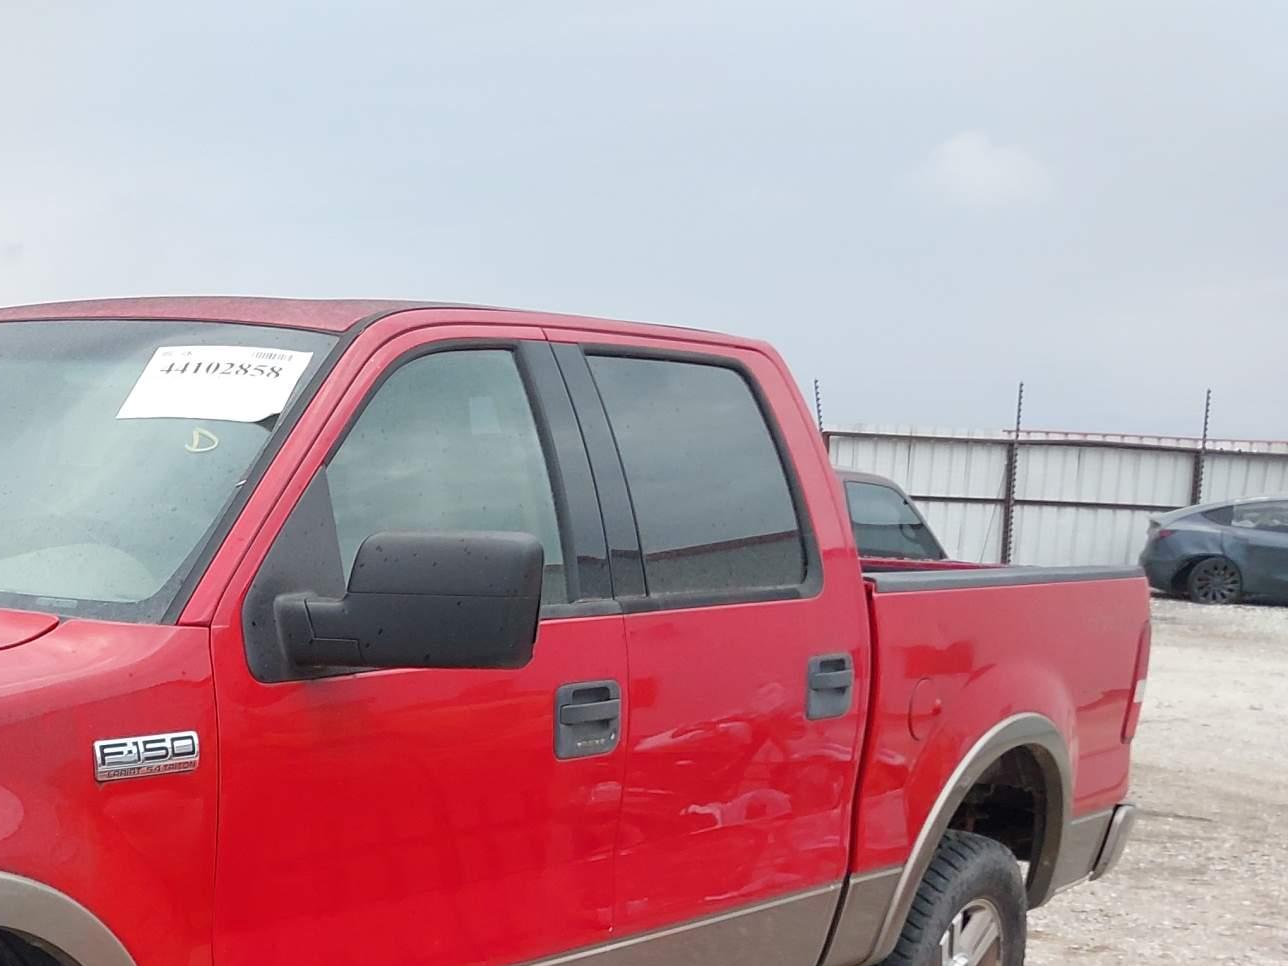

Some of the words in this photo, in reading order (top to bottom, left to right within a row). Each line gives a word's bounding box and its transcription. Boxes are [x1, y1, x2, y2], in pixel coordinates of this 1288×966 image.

[160, 361, 283, 379] 44102858
[184, 426, 219, 453] D
[100, 735, 196, 765] F-150
